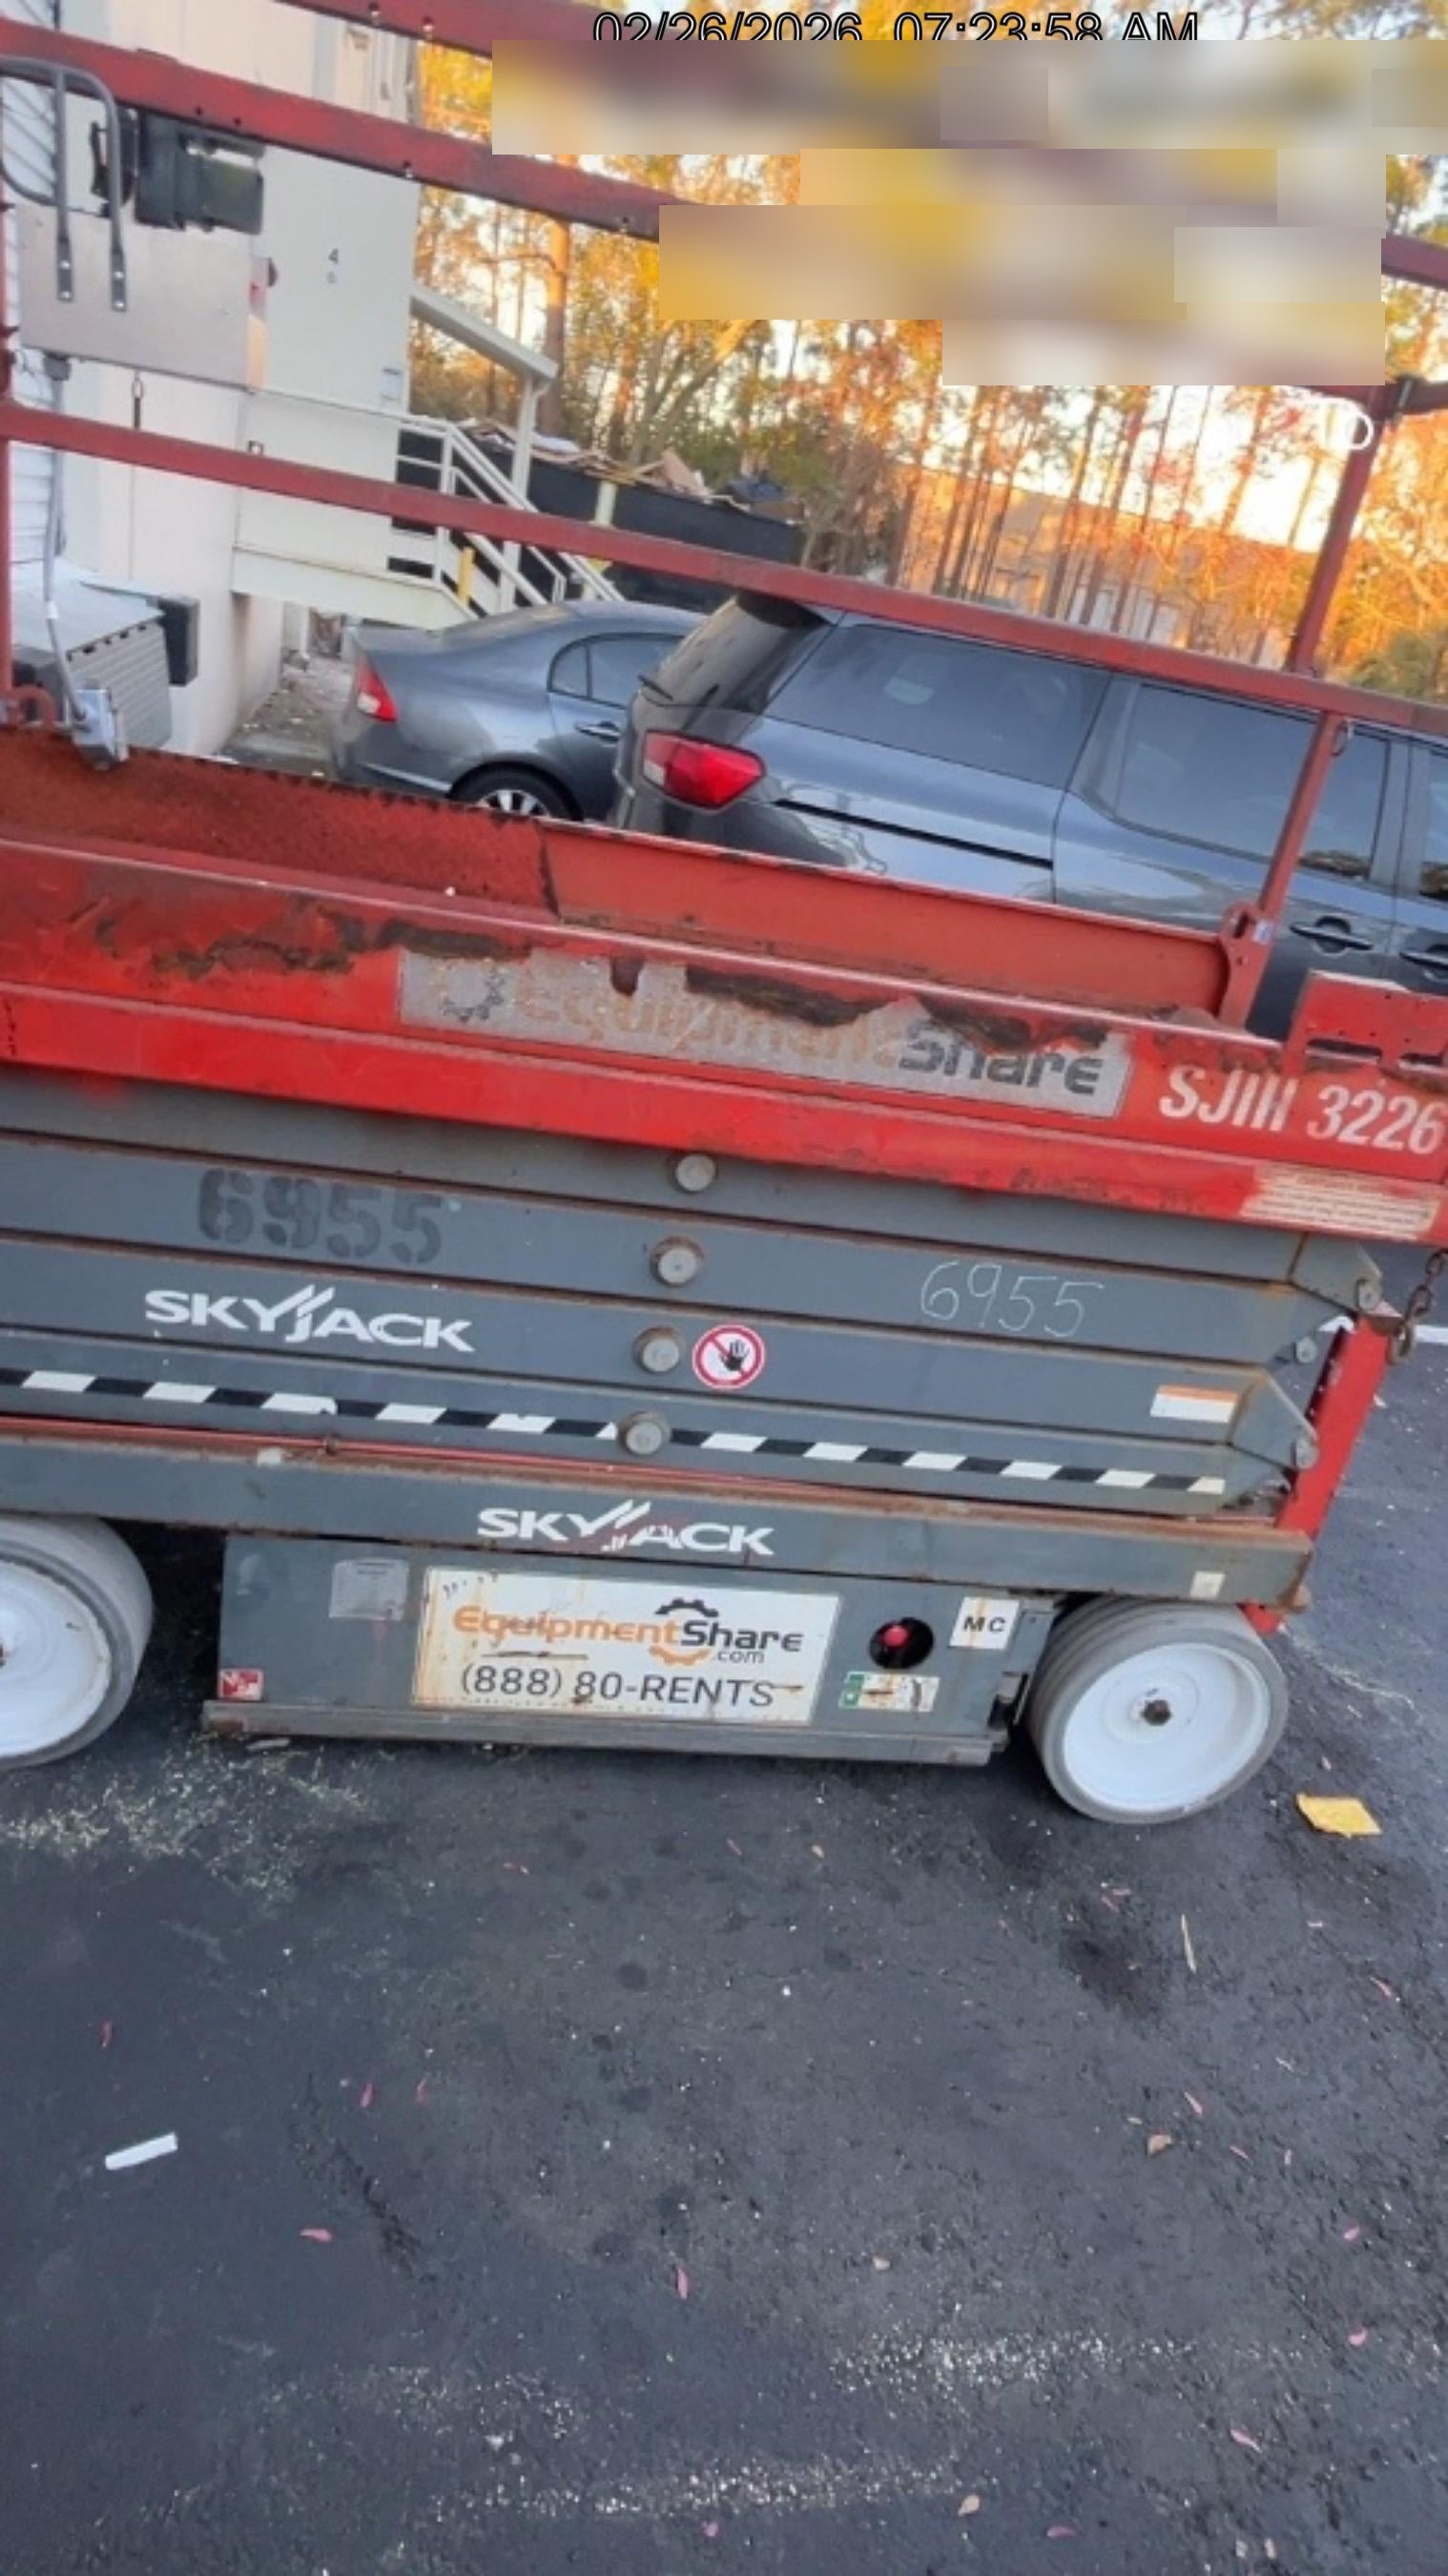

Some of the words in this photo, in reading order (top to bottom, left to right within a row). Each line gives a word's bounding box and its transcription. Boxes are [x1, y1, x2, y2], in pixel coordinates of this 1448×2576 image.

[328, 248, 339, 264] 4
[1306, 1085, 1447, 1154] 3226
[198, 1168, 443, 1265] 6955
[145, 1284, 475, 1352] SKYJACK
[921, 1260, 1105, 1337] 6955
[452, 1605, 804, 1652] EquipmentShare
[462, 1663, 563, 1698] (888)
[574, 1671, 775, 1707] 80-RENTS
